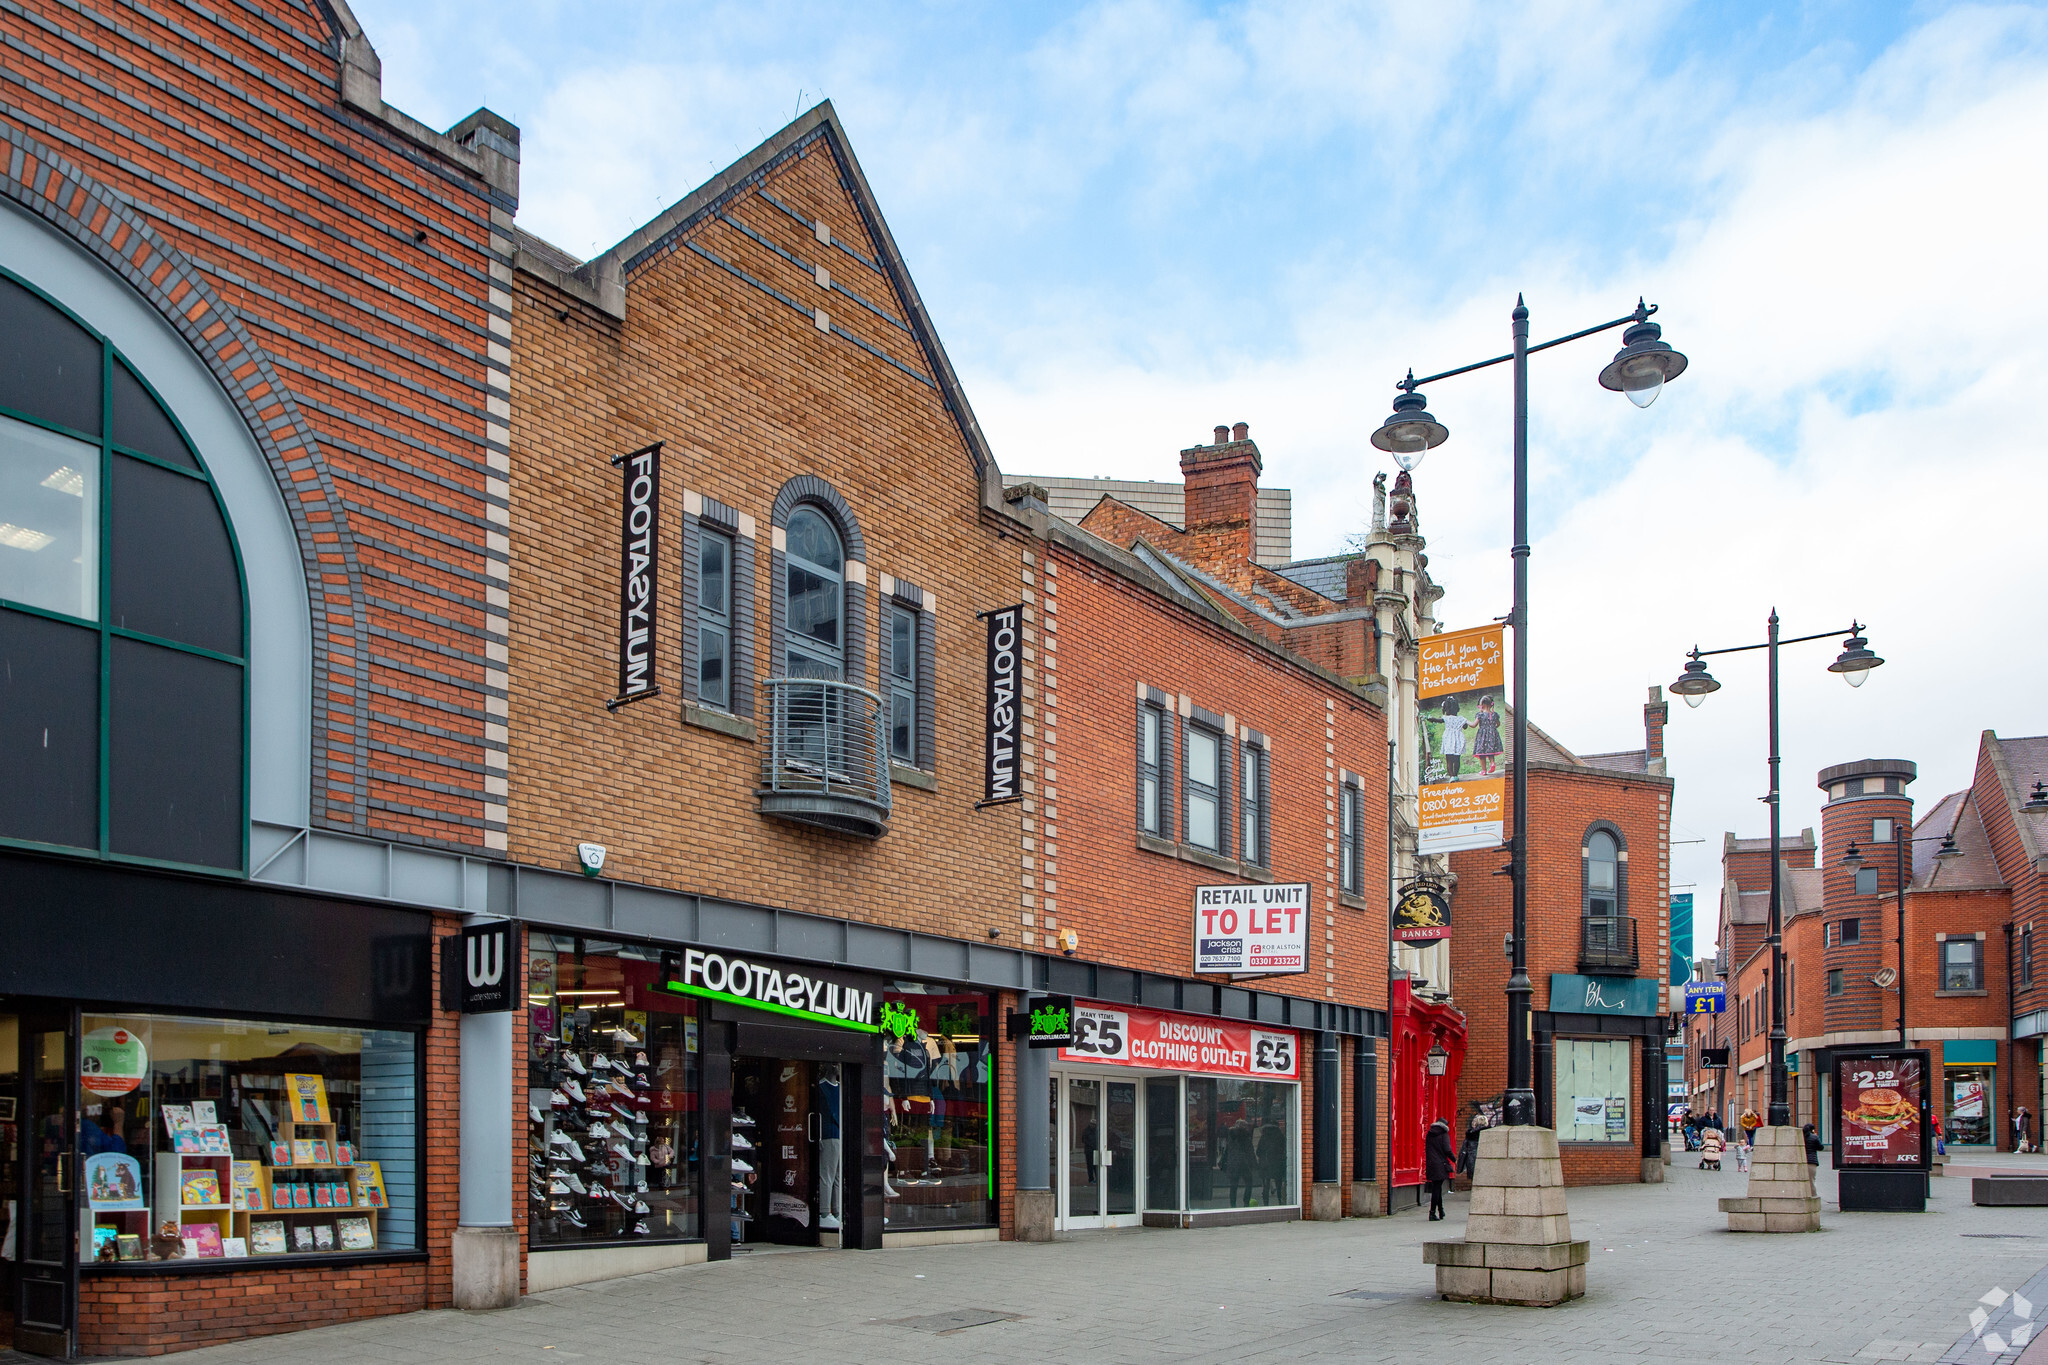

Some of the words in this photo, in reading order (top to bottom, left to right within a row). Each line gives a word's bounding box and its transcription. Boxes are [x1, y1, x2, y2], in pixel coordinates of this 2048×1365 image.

[626, 451, 653, 695] FOOTASYLUM
[1422, 642, 1456, 660] Could
[1459, 643, 1478, 660] you
[1481, 636, 1498, 651] be
[1422, 662, 1444, 675] the
[1445, 657, 1485, 672] future
[1487, 650, 1500, 664] of
[1422, 666, 1484, 690] fostering?
[992, 609, 1015, 800] FOOTASYLUM
[1422, 786, 1466, 799] Freephone
[1422, 799, 1448, 812] 0800
[1449, 797, 1471, 809] 923
[1472, 792, 1501, 806] 3706
[1201, 889, 1258, 905] RETAIL
[1263, 887, 1303, 903] UNIT
[1201, 908, 1238, 935] TO
[1248, 907, 1302, 935] LET
[1208, 939, 1242, 949] jackson
[1401, 929, 1441, 938] BANKS'S
[1221, 946, 1241, 954] criss
[1250, 957, 1272, 965] 03301
[1273, 956, 1300, 965] 233224
[684, 948, 873, 1025] FOOTASYLUM
[1585, 981, 1625, 1009] Bhs
[1080, 1010, 1096, 1019] MANY
[1098, 1013, 1114, 1021] ITEMS
[1695, 997, 1715, 1013] £1
[1029, 1033, 1071, 1041] FOOTASYLUM.COM
[1073, 1017, 1123, 1056] £5
[1159, 1021, 1223, 1045] DISCOUNT
[1131, 1039, 1198, 1063] CLOTHING
[1201, 1046, 1248, 1068] OUTLET
[1256, 1039, 1291, 1071] £5
[1852, 1070, 1895, 1089] £2.99
[1896, 1154, 1919, 1162] KFC
